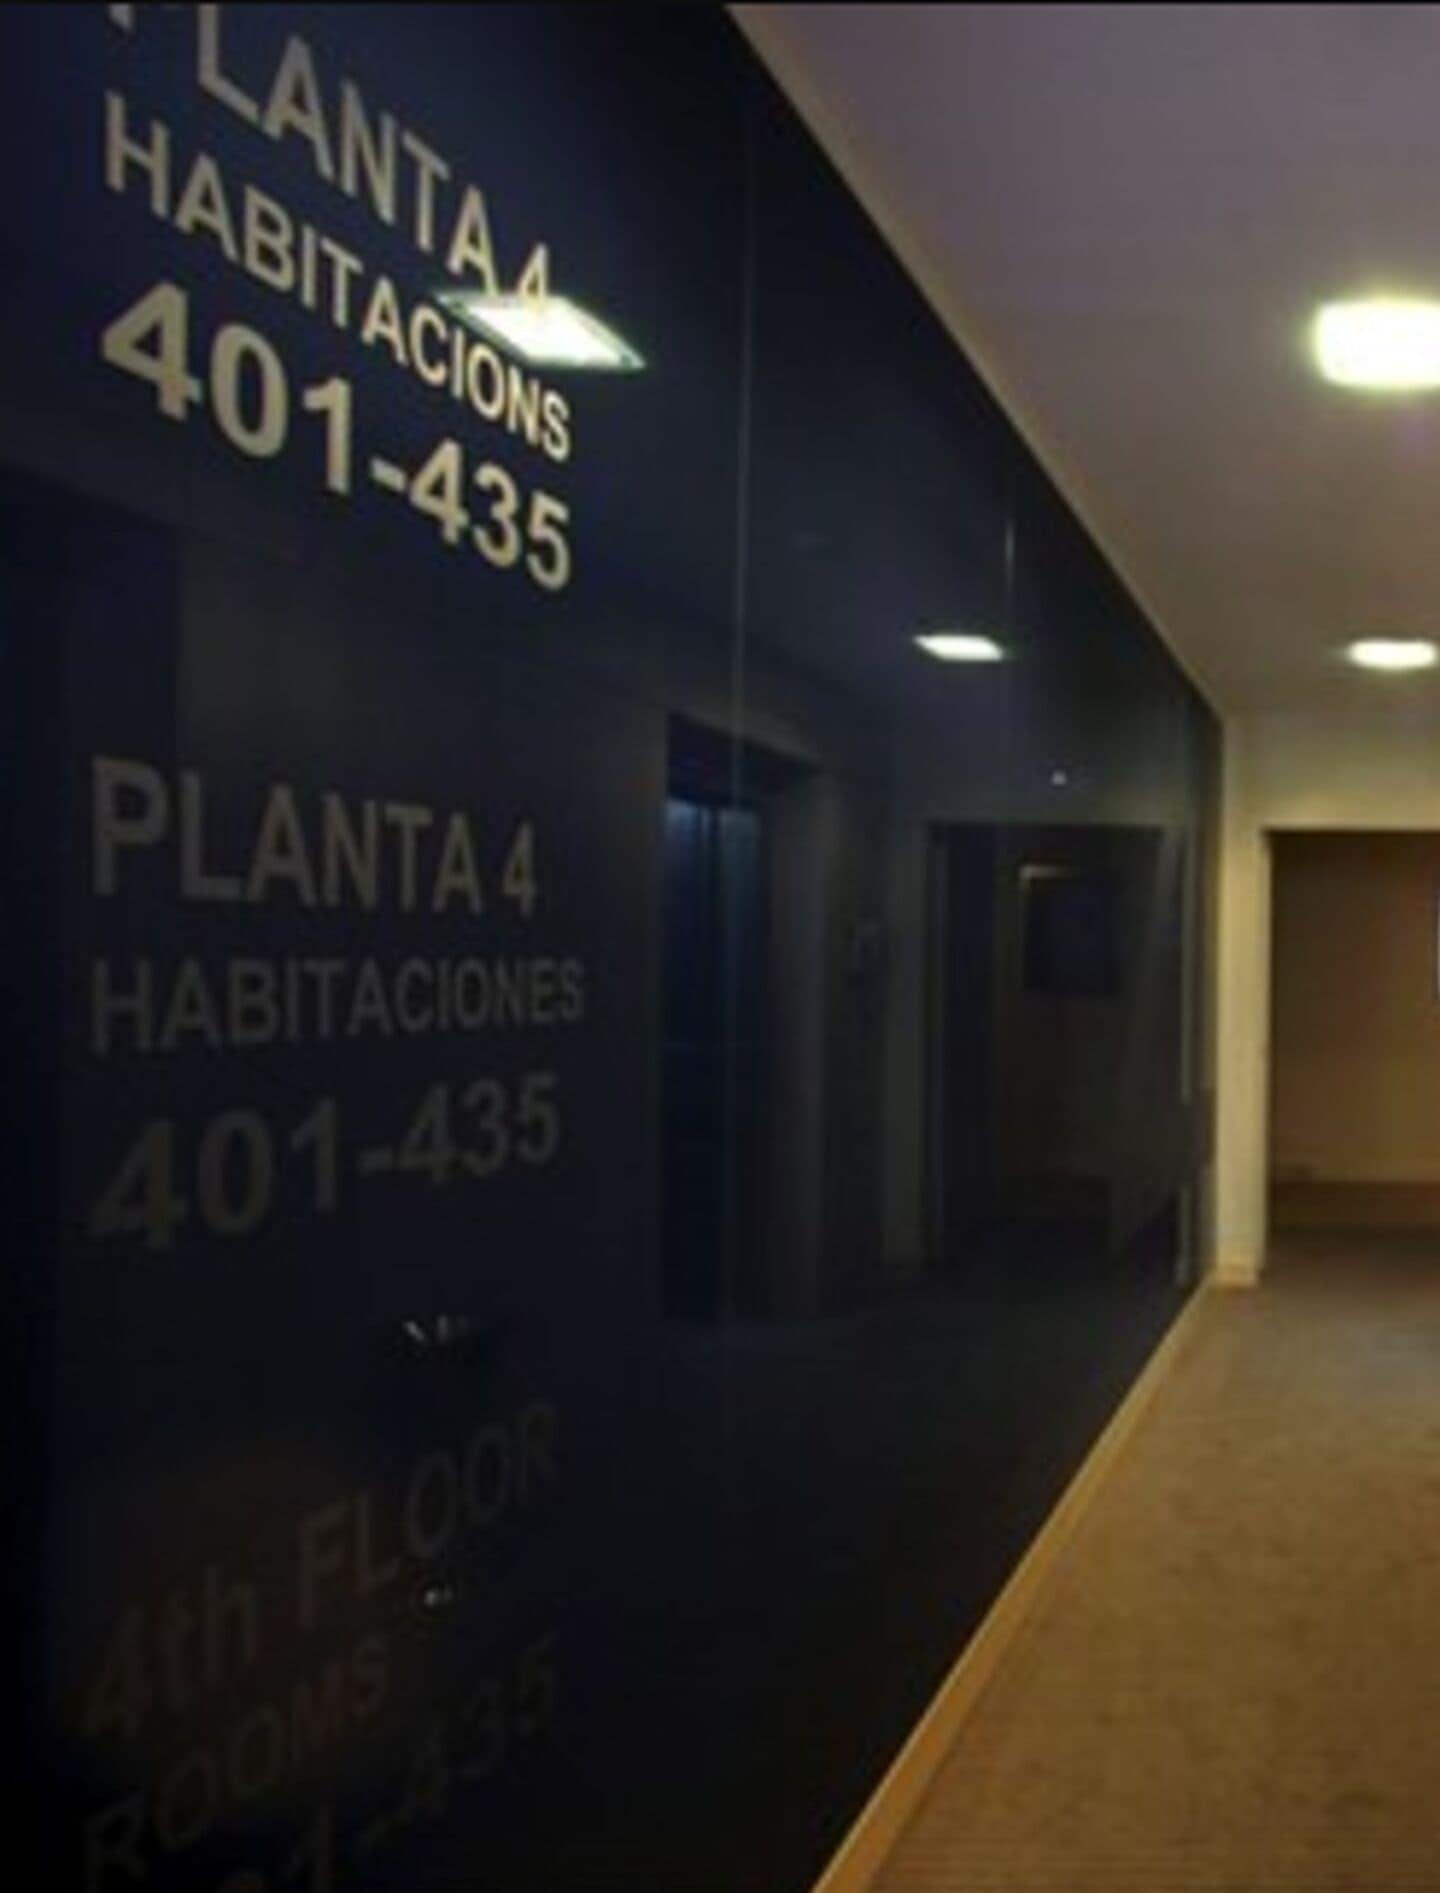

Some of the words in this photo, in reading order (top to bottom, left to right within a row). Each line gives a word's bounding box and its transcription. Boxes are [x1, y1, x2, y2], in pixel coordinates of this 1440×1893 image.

[106, 4, 498, 297] LANTA
[103, 88, 570, 463] HABITACIONS
[101, 280, 572, 593] 401-435
[91, 753, 483, 915] PLANTA
[500, 818, 538, 918] 4
[90, 954, 586, 1056] HABITACIONES
[87, 1070, 562, 1251] 401-435
[298, 1398, 560, 1632] FLOOR
